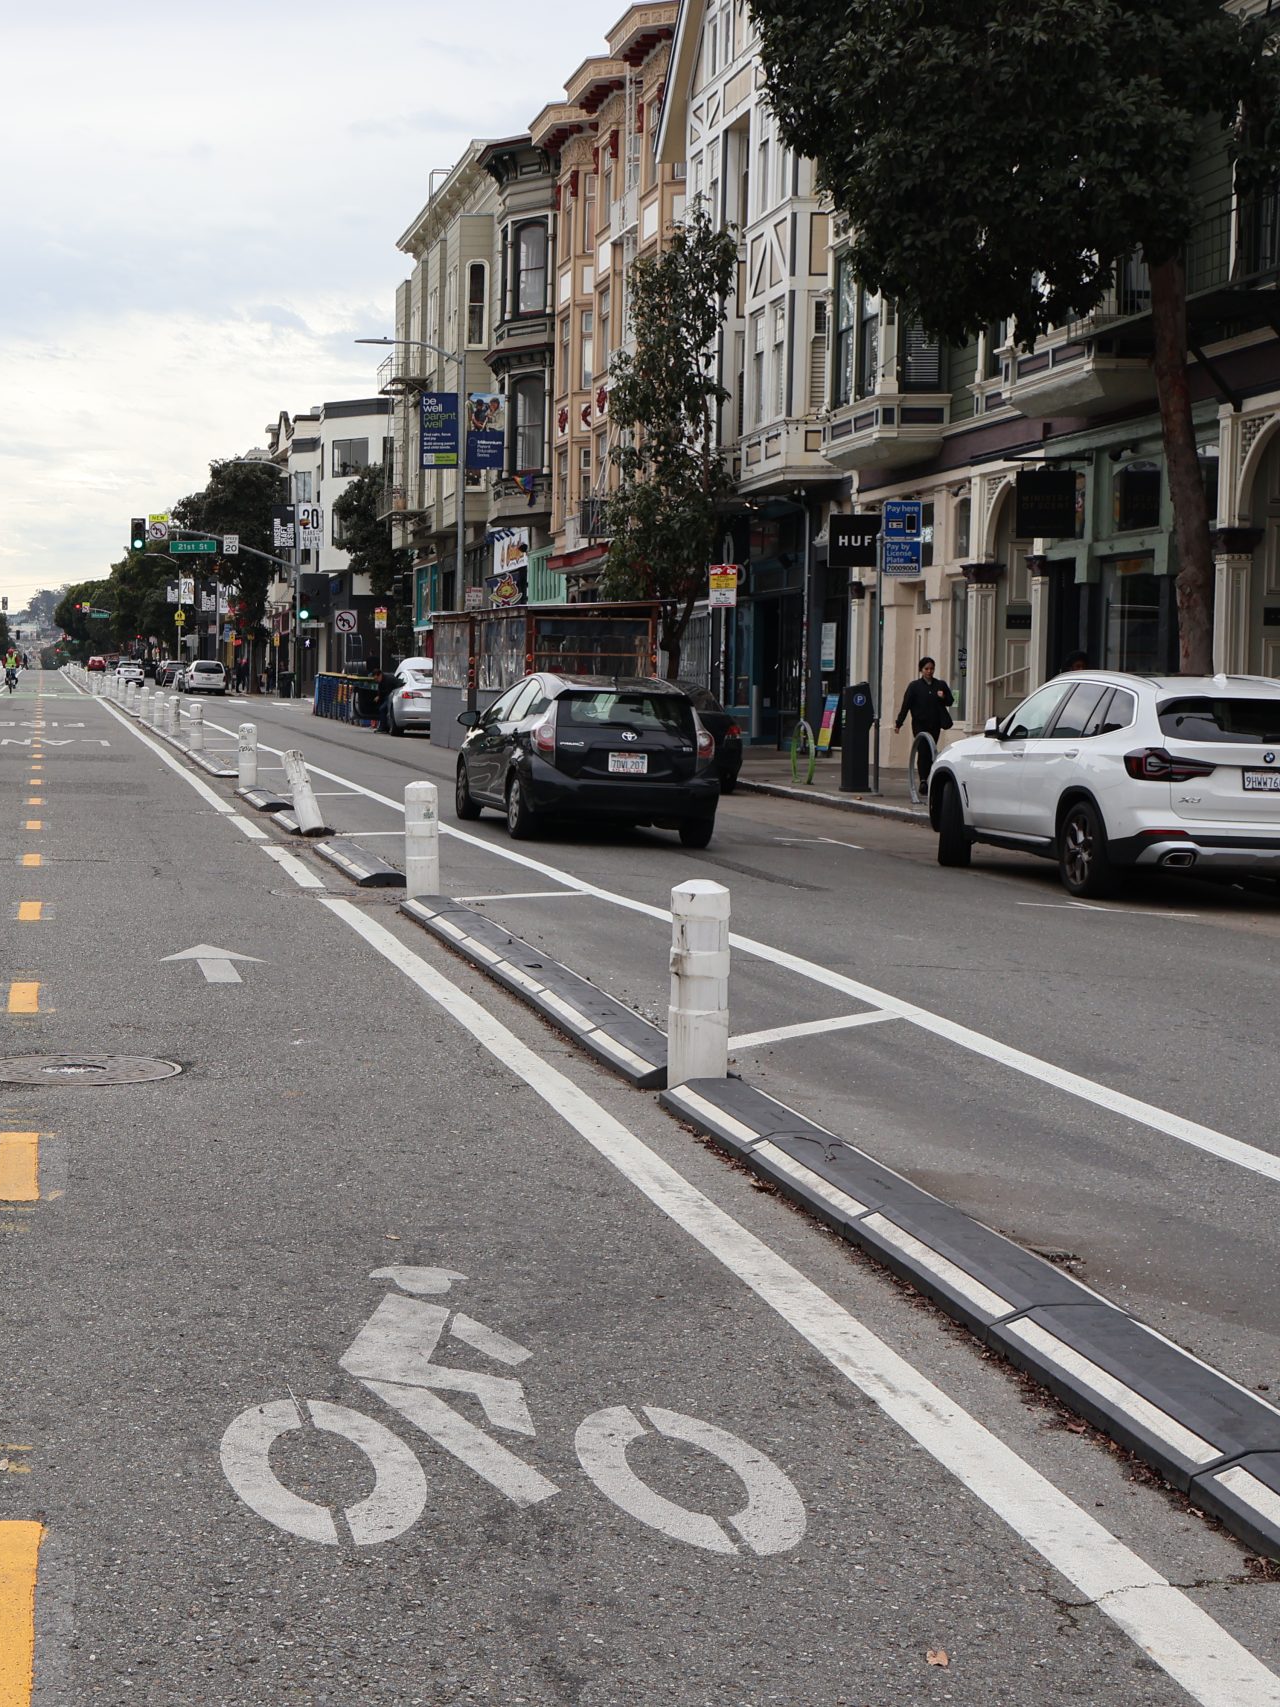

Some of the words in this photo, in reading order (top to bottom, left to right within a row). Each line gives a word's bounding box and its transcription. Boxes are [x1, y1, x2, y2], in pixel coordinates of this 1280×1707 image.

[423, 397, 436, 405] be
[423, 404, 442, 412] well
[424, 412, 456, 421] parent
[424, 420, 442, 428] well
[887, 505, 900, 513] Pay
[302, 508, 319, 530] 20
[273, 518, 281, 547] MUSEUM
[838, 535, 873, 547] HUF
[224, 544, 238, 553] 20
[886, 543, 899, 551] Pay
[901, 543, 910, 551] by
[1246, 776, 1280, 787] 9HWW76
